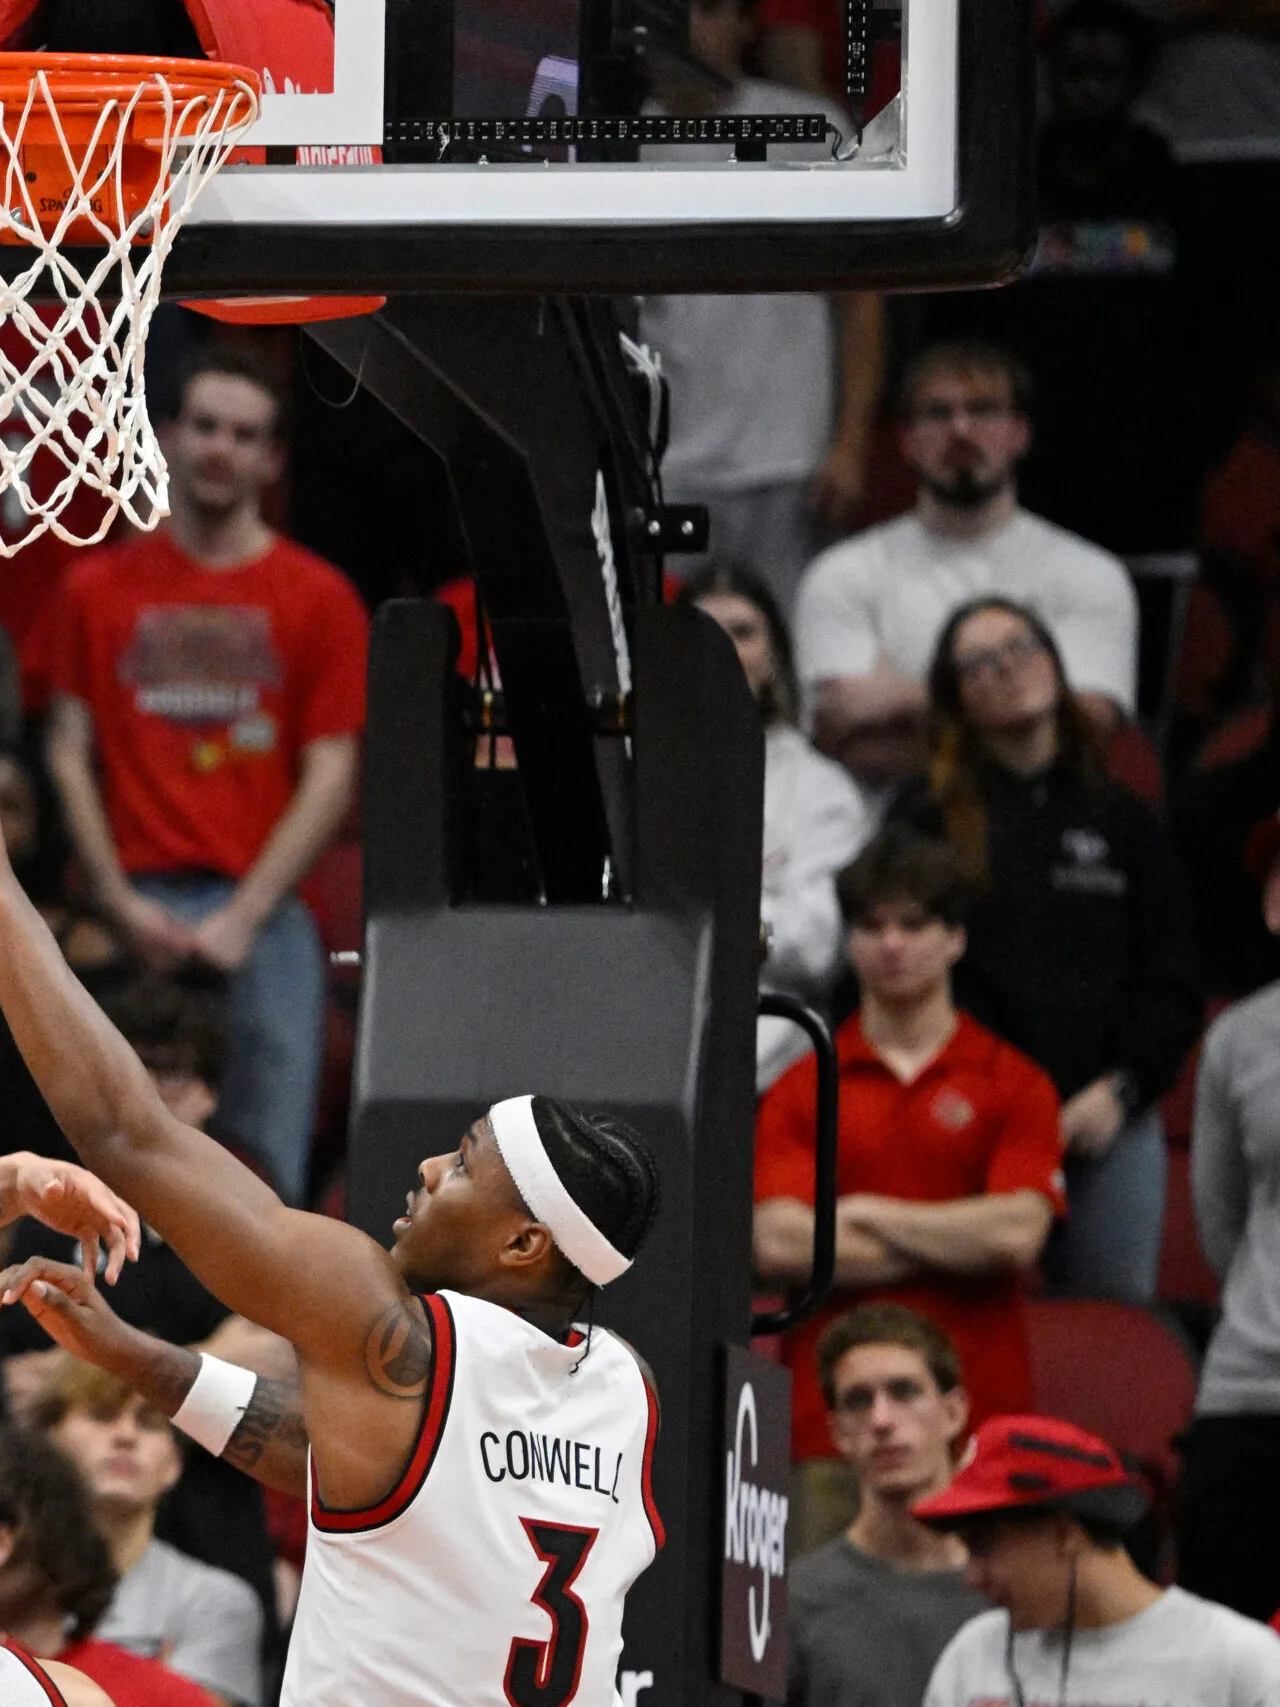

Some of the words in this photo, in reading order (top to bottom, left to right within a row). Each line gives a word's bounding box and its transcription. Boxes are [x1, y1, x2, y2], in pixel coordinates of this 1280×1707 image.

[480, 1430, 623, 1504] CONWELL
[725, 1381, 788, 1662] Kroger
[503, 1515, 600, 1707] 3
